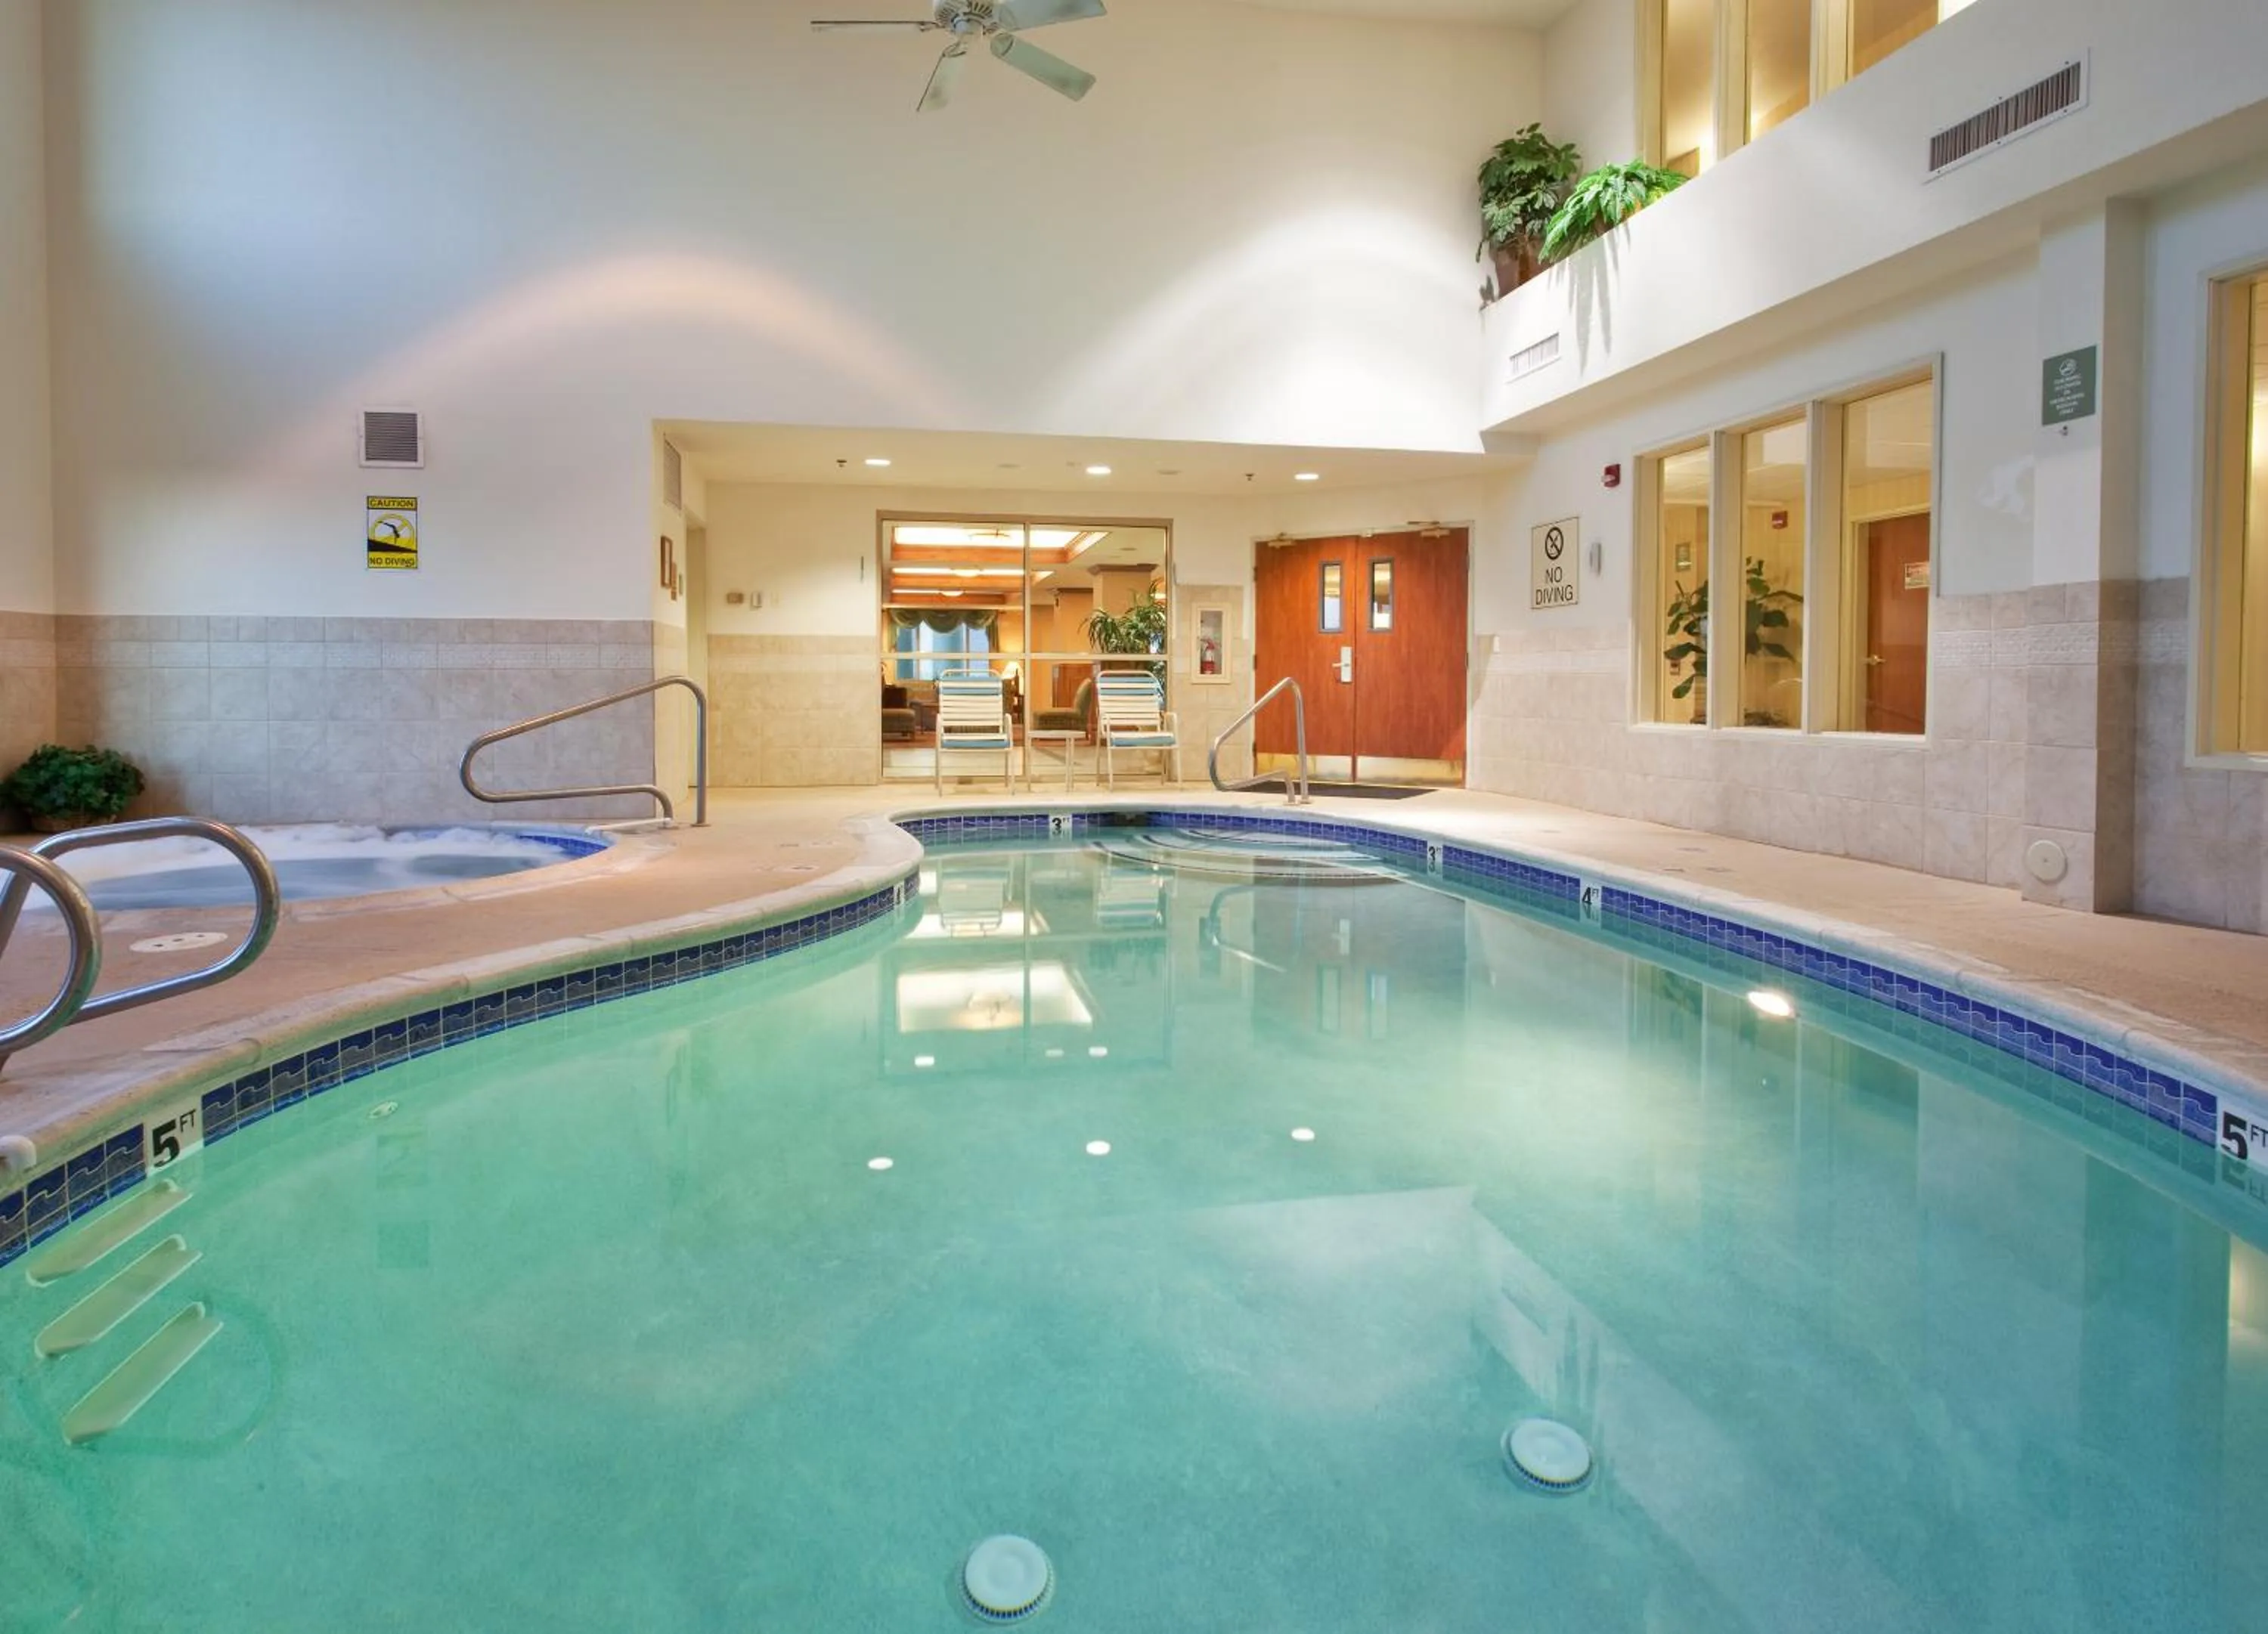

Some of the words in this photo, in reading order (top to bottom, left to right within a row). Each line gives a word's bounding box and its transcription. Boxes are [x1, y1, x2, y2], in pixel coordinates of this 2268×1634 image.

[370, 499, 414, 507] CAUTION
[370, 557, 383, 565] NO
[385, 557, 414, 567] DIVING
[1546, 566, 1563, 583] NO
[1535, 584, 1573, 605] DIVING
[1582, 887, 1591, 905] 4
[152, 1119, 181, 1168] 5
[179, 1108, 197, 1133] FT
[2221, 1110, 2248, 1160] 5
[2251, 1124, 2268, 1148] FT
